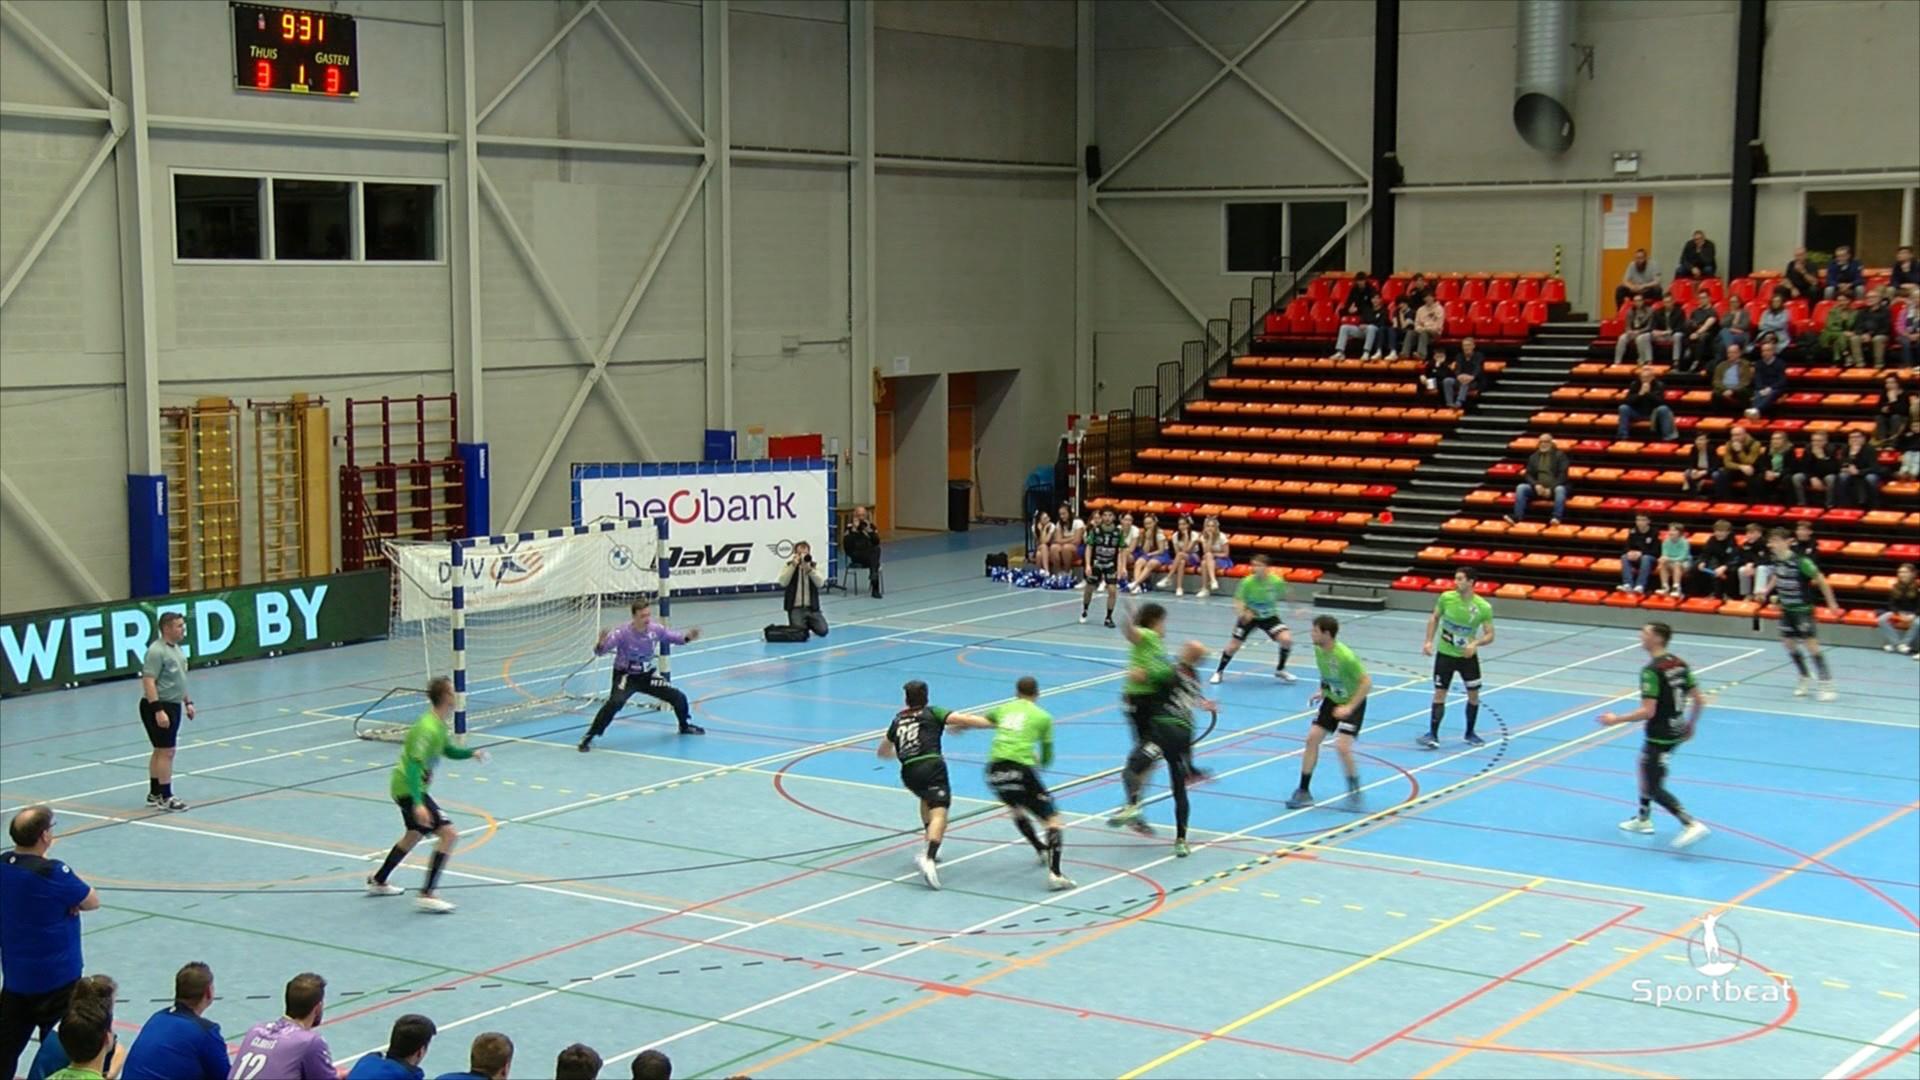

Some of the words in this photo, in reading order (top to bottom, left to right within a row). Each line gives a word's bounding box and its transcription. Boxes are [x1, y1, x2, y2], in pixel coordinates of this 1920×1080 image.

[250, 45, 279, 60] THUIS
[315, 52, 350, 66] GASTEN
[258, 62, 270, 87] 3
[299, 64, 304, 84] 1
[327, 68, 339, 92] 3
[256, 584, 328, 648] BY
[233, 1051, 267, 1080] 12
